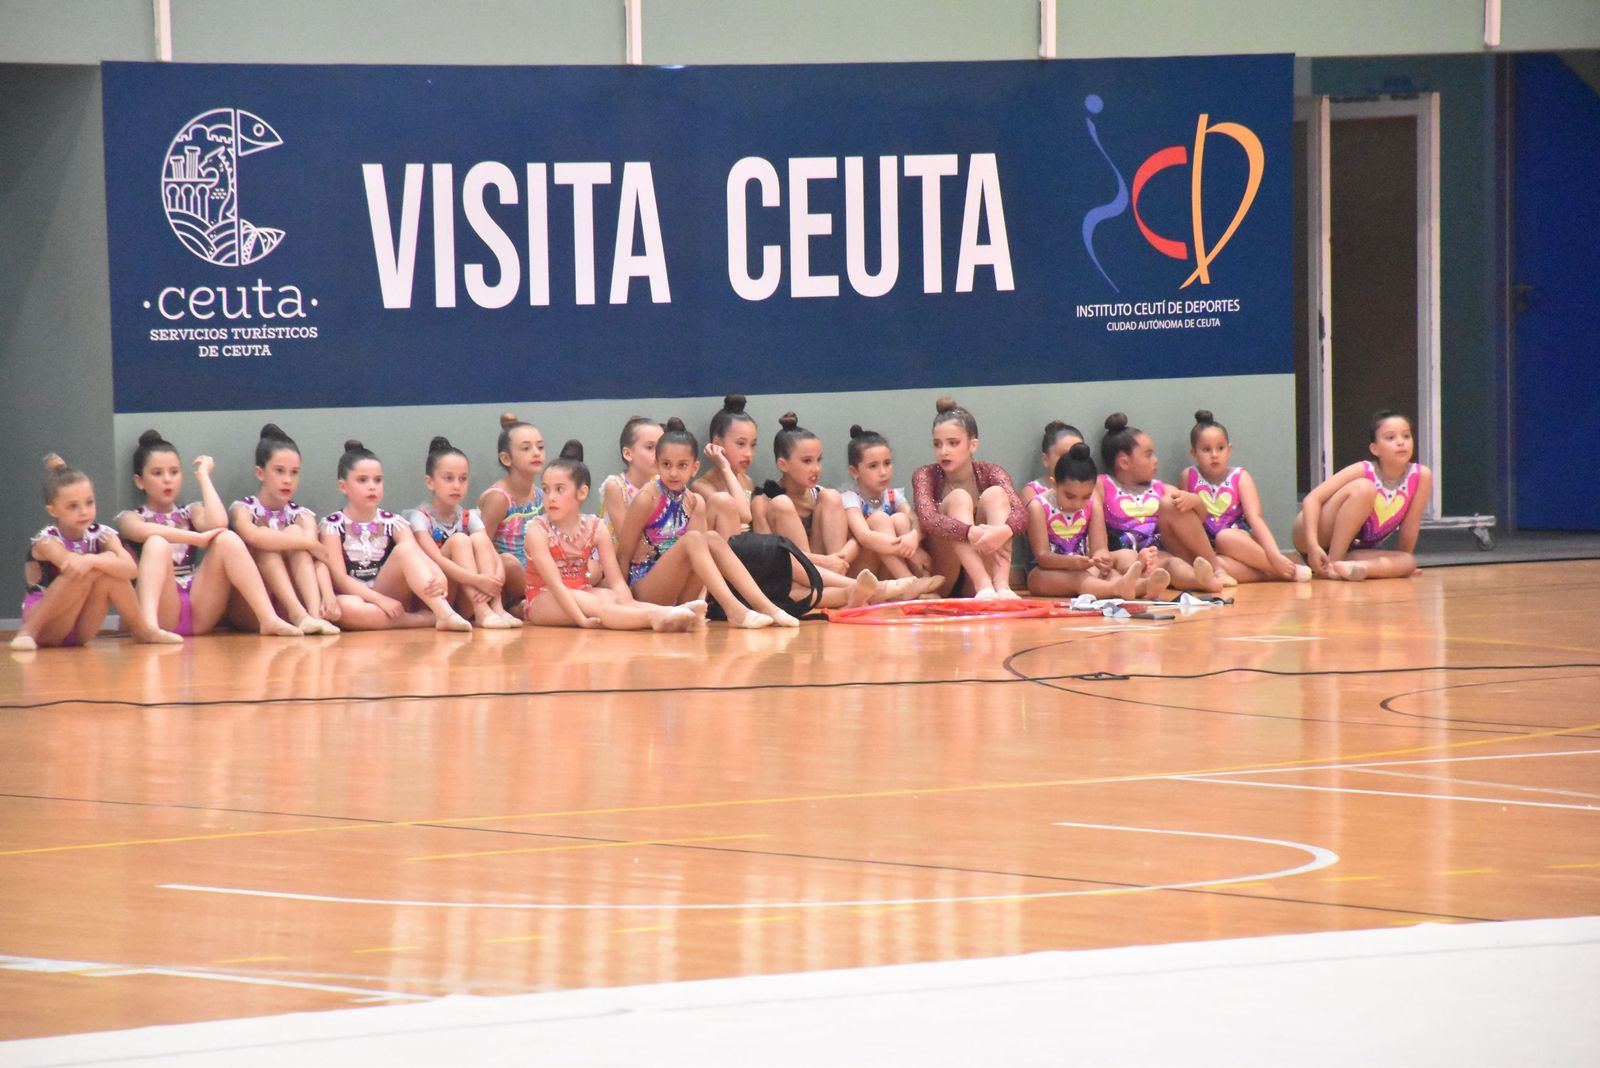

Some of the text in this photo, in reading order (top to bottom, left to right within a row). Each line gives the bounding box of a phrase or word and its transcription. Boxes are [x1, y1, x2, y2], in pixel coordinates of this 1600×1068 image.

[361, 152, 1016, 310] VISITA CEUTA
[1076, 299, 1241, 318] INSTITUTO CEUTÍ DE DEPORTES
[150, 324, 318, 341] SERVICIOS TURÍSTICOS
[1106, 317, 1221, 331] CIUDAD AUTÓNOMA DE CEUTA
[198, 344, 272, 357] DE CEUTA
